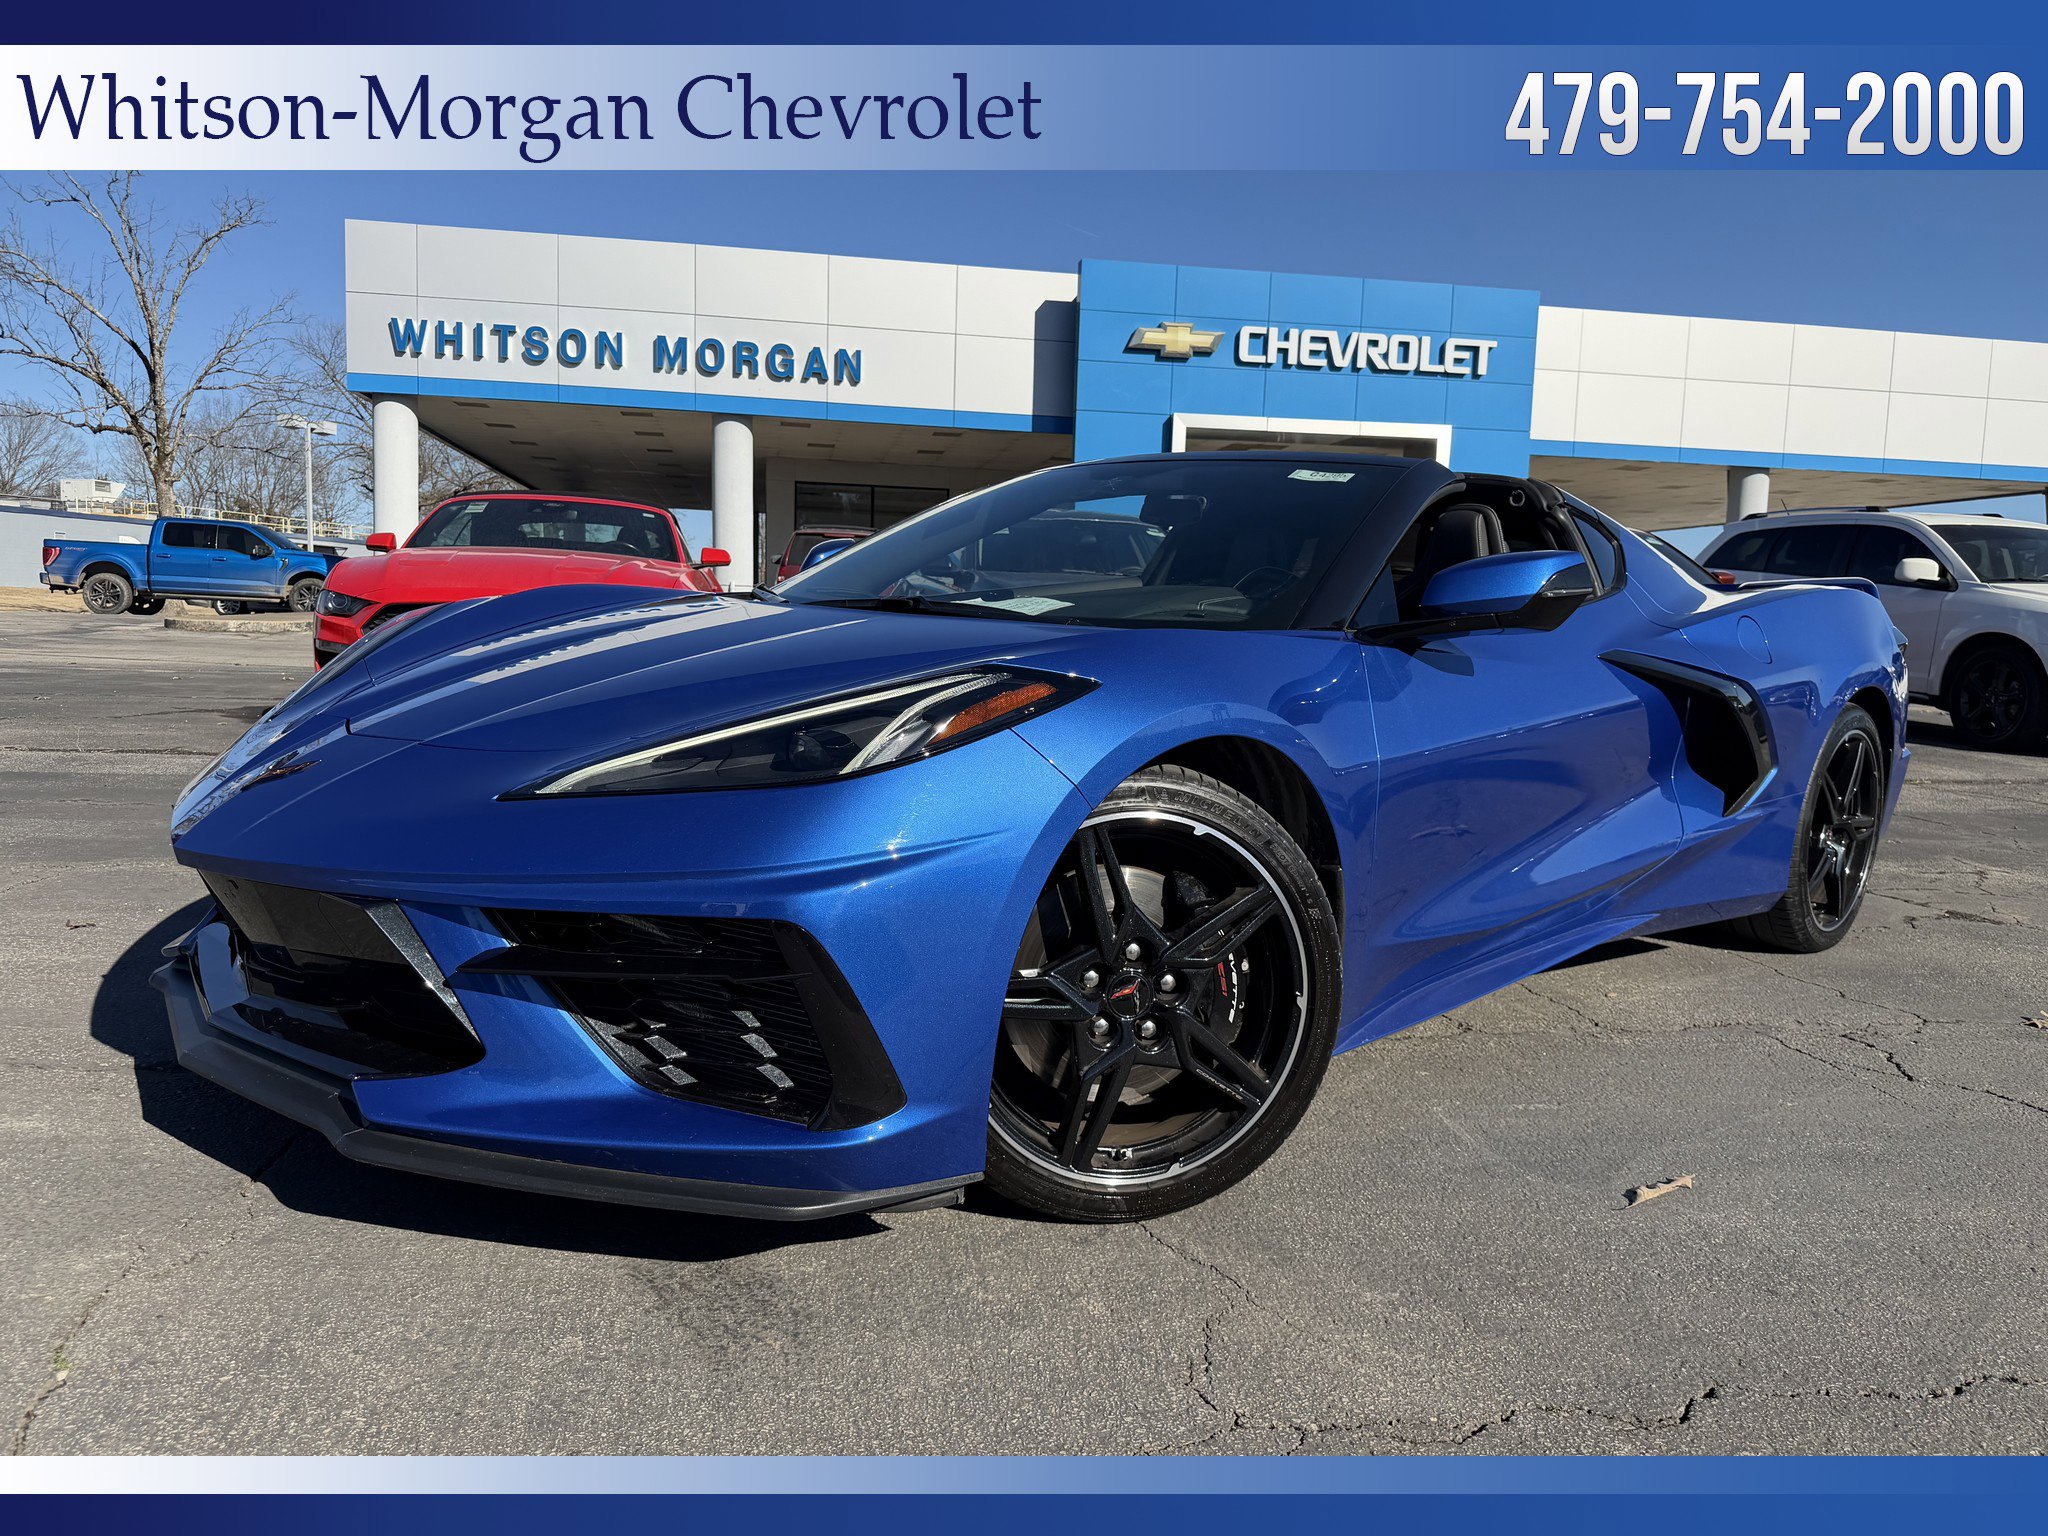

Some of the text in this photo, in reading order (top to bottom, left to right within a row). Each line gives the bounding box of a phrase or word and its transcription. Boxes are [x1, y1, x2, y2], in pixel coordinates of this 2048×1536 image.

[388, 317, 862, 385] WHITSON MORGAN
[1237, 325, 1498, 376] CHEVROLET
[1174, 791, 1263, 839] MICHELIN
[1196, 1069, 1243, 1100] CORVETTE
